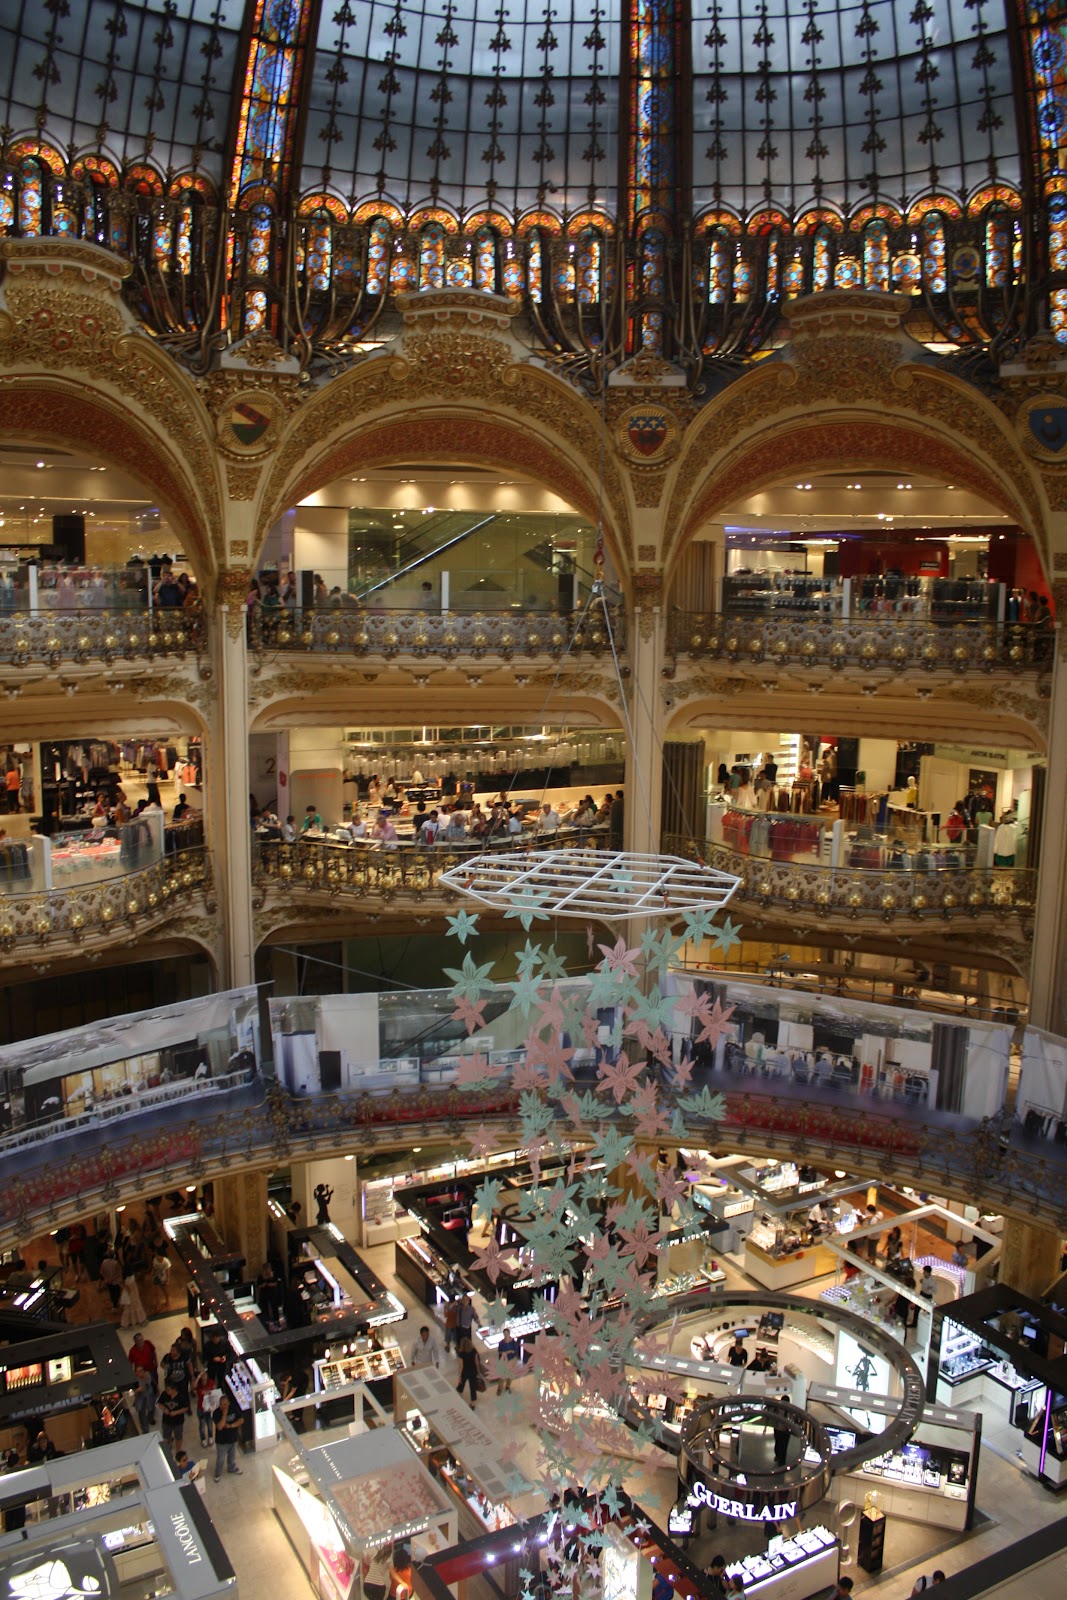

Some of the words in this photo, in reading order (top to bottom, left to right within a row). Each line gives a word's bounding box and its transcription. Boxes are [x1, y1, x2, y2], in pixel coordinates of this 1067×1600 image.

[265, 758, 276, 773] 2
[943, 1315, 982, 1343] GIVENCHY
[693, 1481, 797, 1521] GUERLAIN
[170, 1511, 202, 1566] LANCÔME
